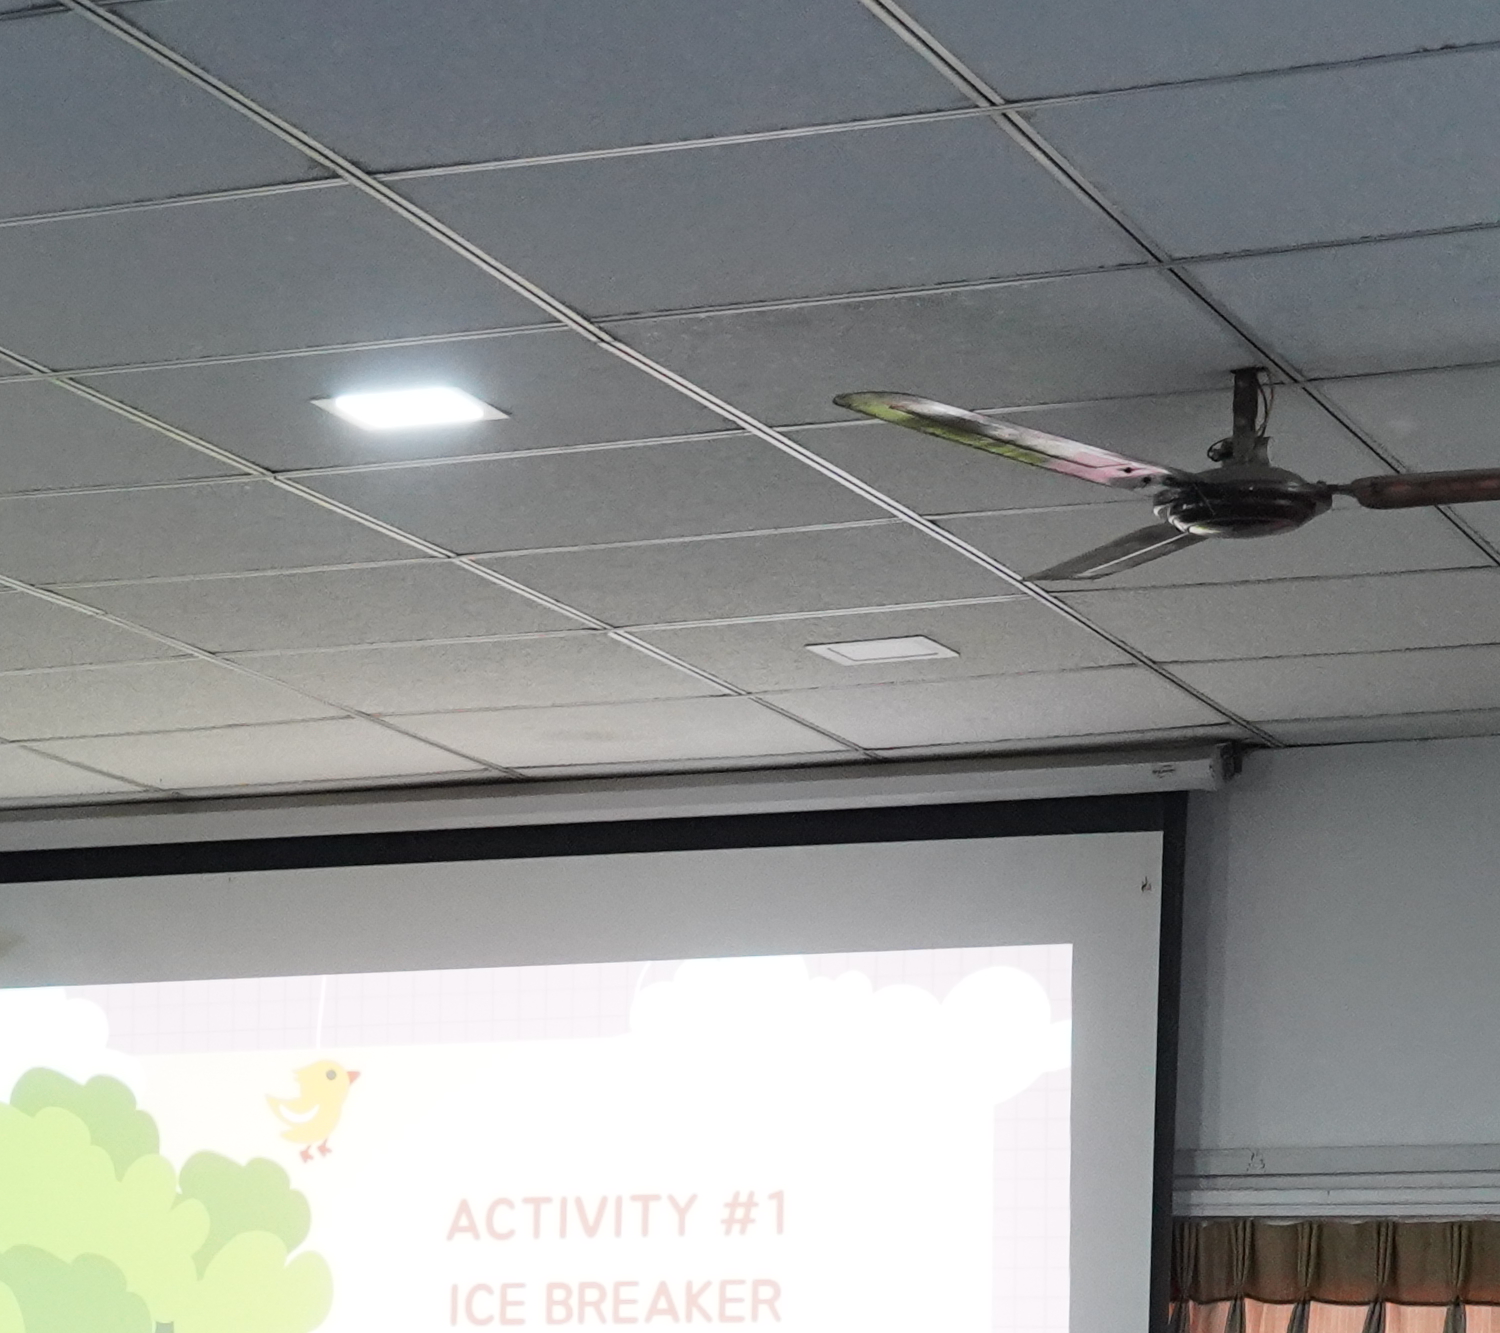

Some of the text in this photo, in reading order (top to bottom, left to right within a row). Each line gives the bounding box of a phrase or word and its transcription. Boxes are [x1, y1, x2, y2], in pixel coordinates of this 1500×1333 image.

[446, 1188, 786, 1241] ACTIVITY #1
[449, 1278, 783, 1327] ICE BREAKER
